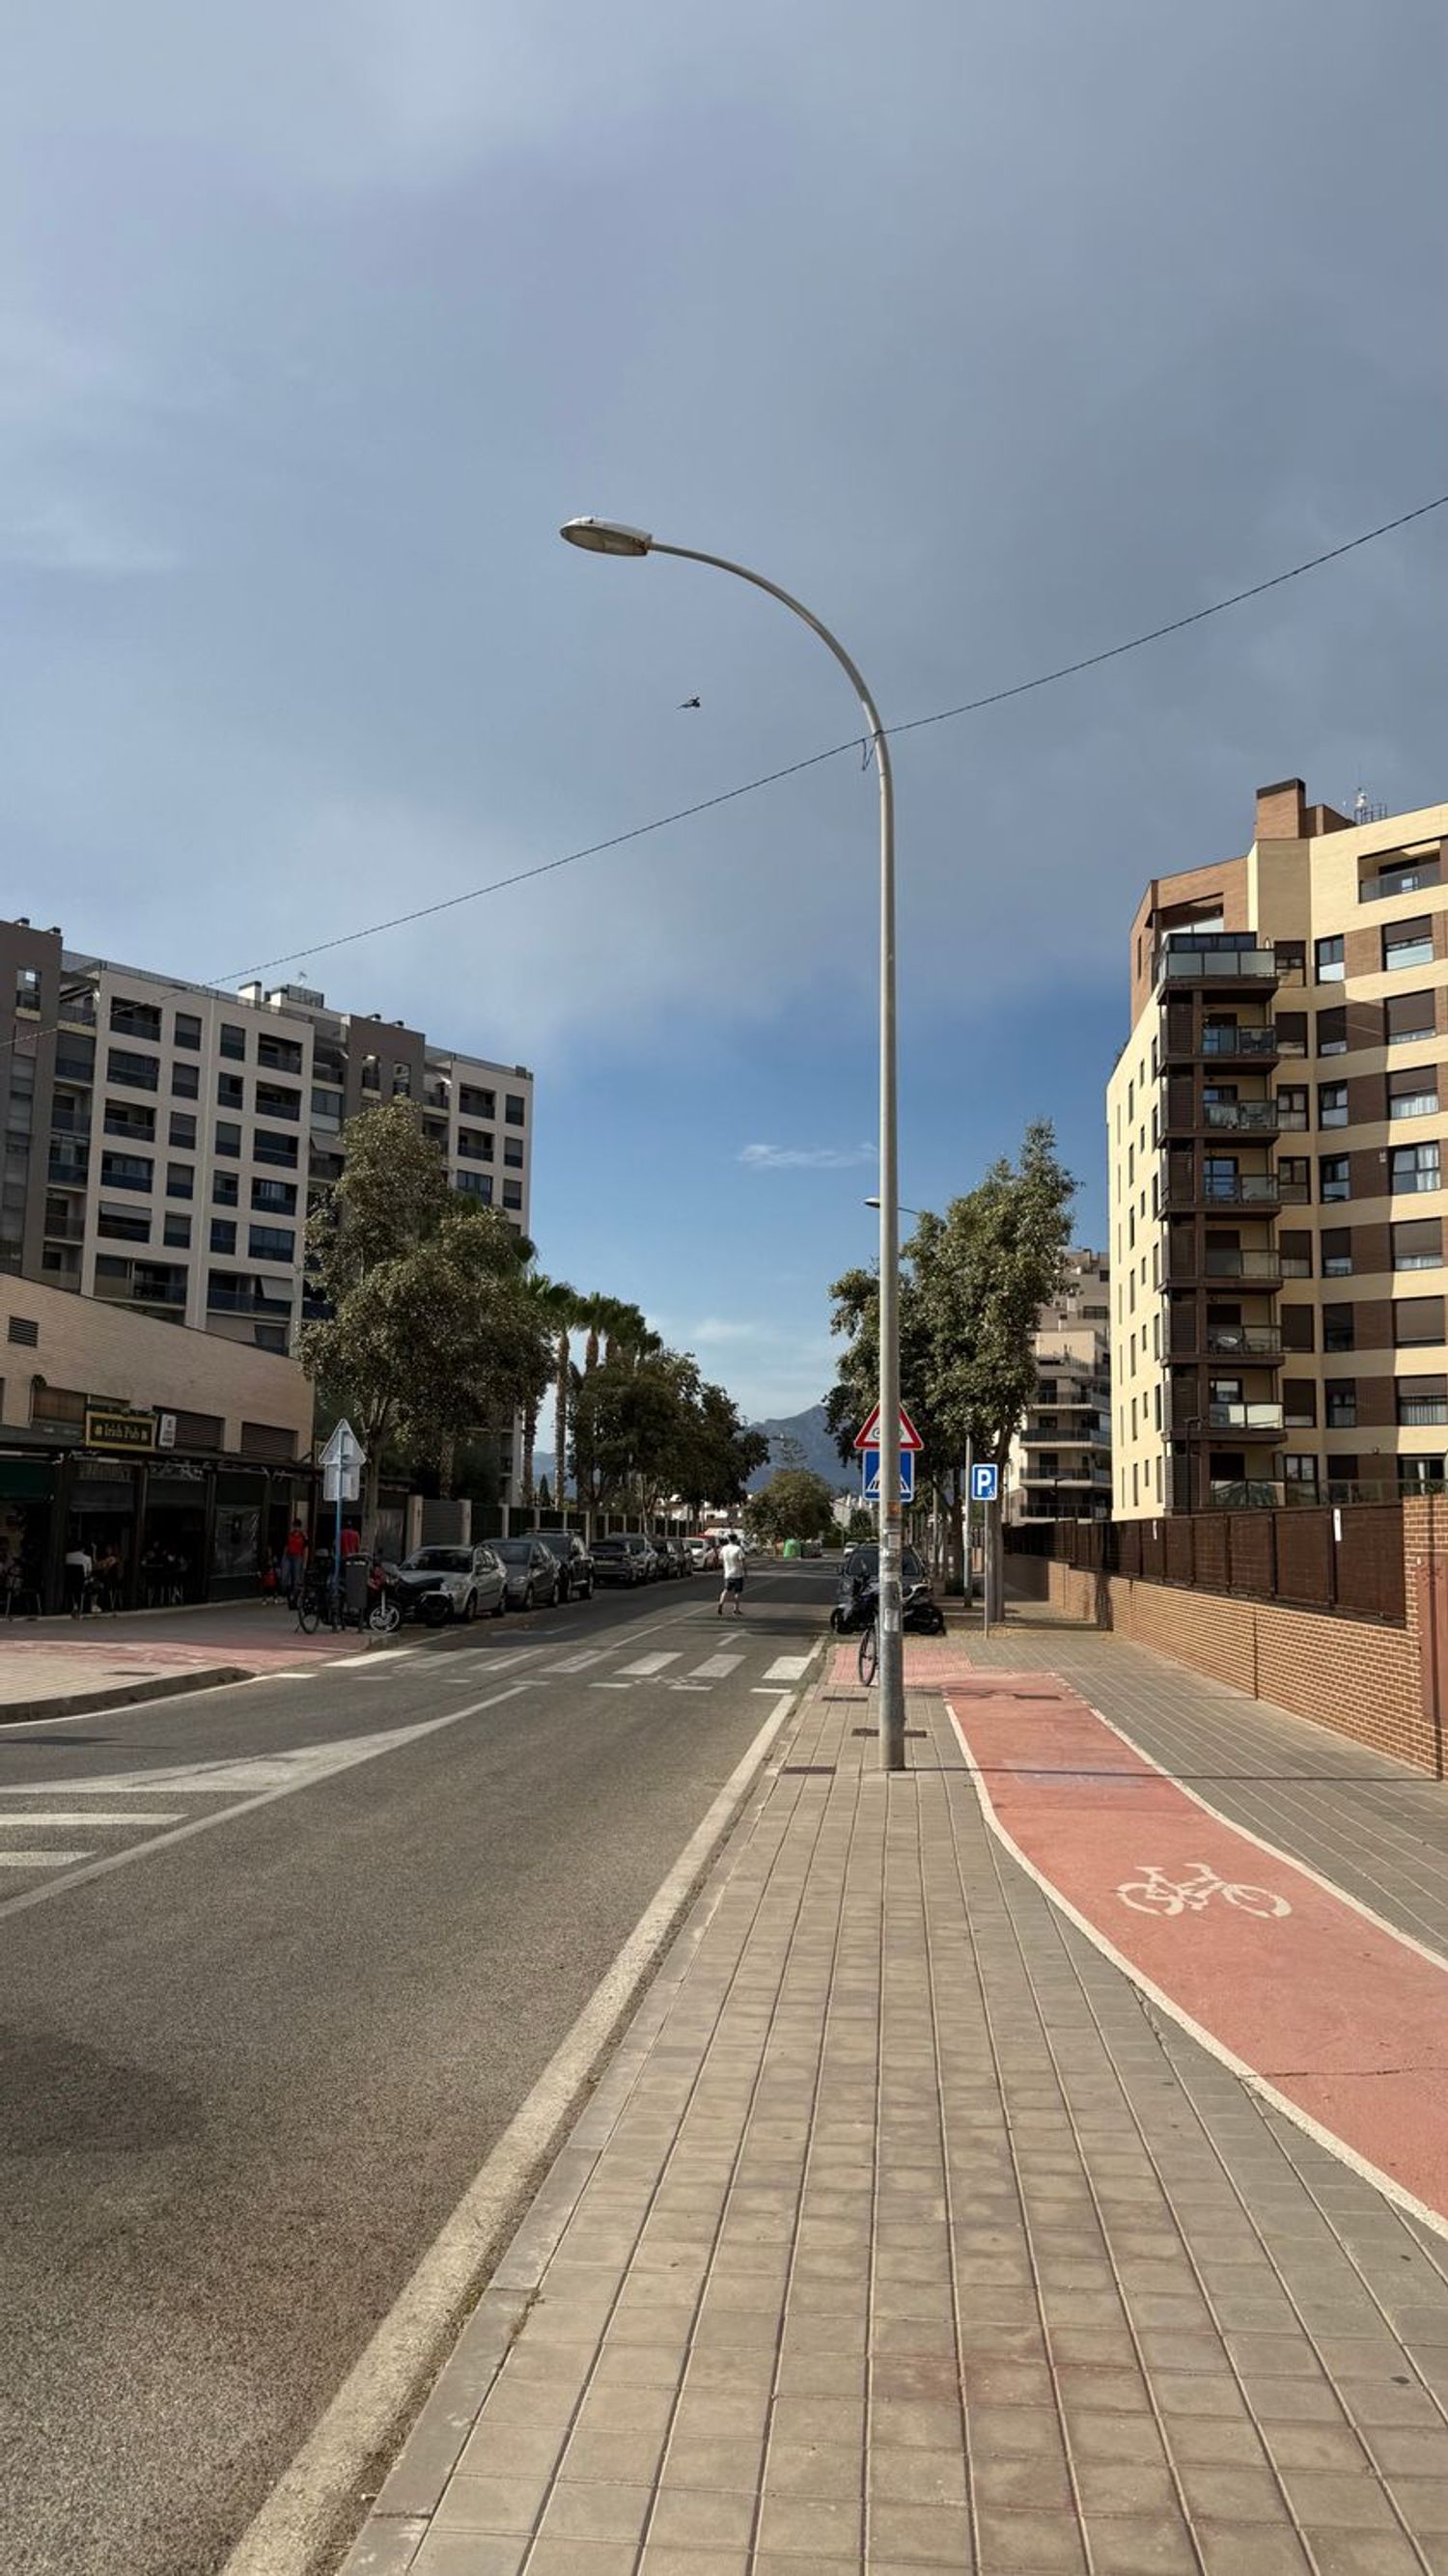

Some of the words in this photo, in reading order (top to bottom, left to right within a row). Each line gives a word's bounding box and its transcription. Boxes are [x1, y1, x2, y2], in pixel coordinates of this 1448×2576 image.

[104, 1423, 123, 1437] Irish
[124, 1426, 139, 1439] Pub
[977, 1469, 991, 1495] P
